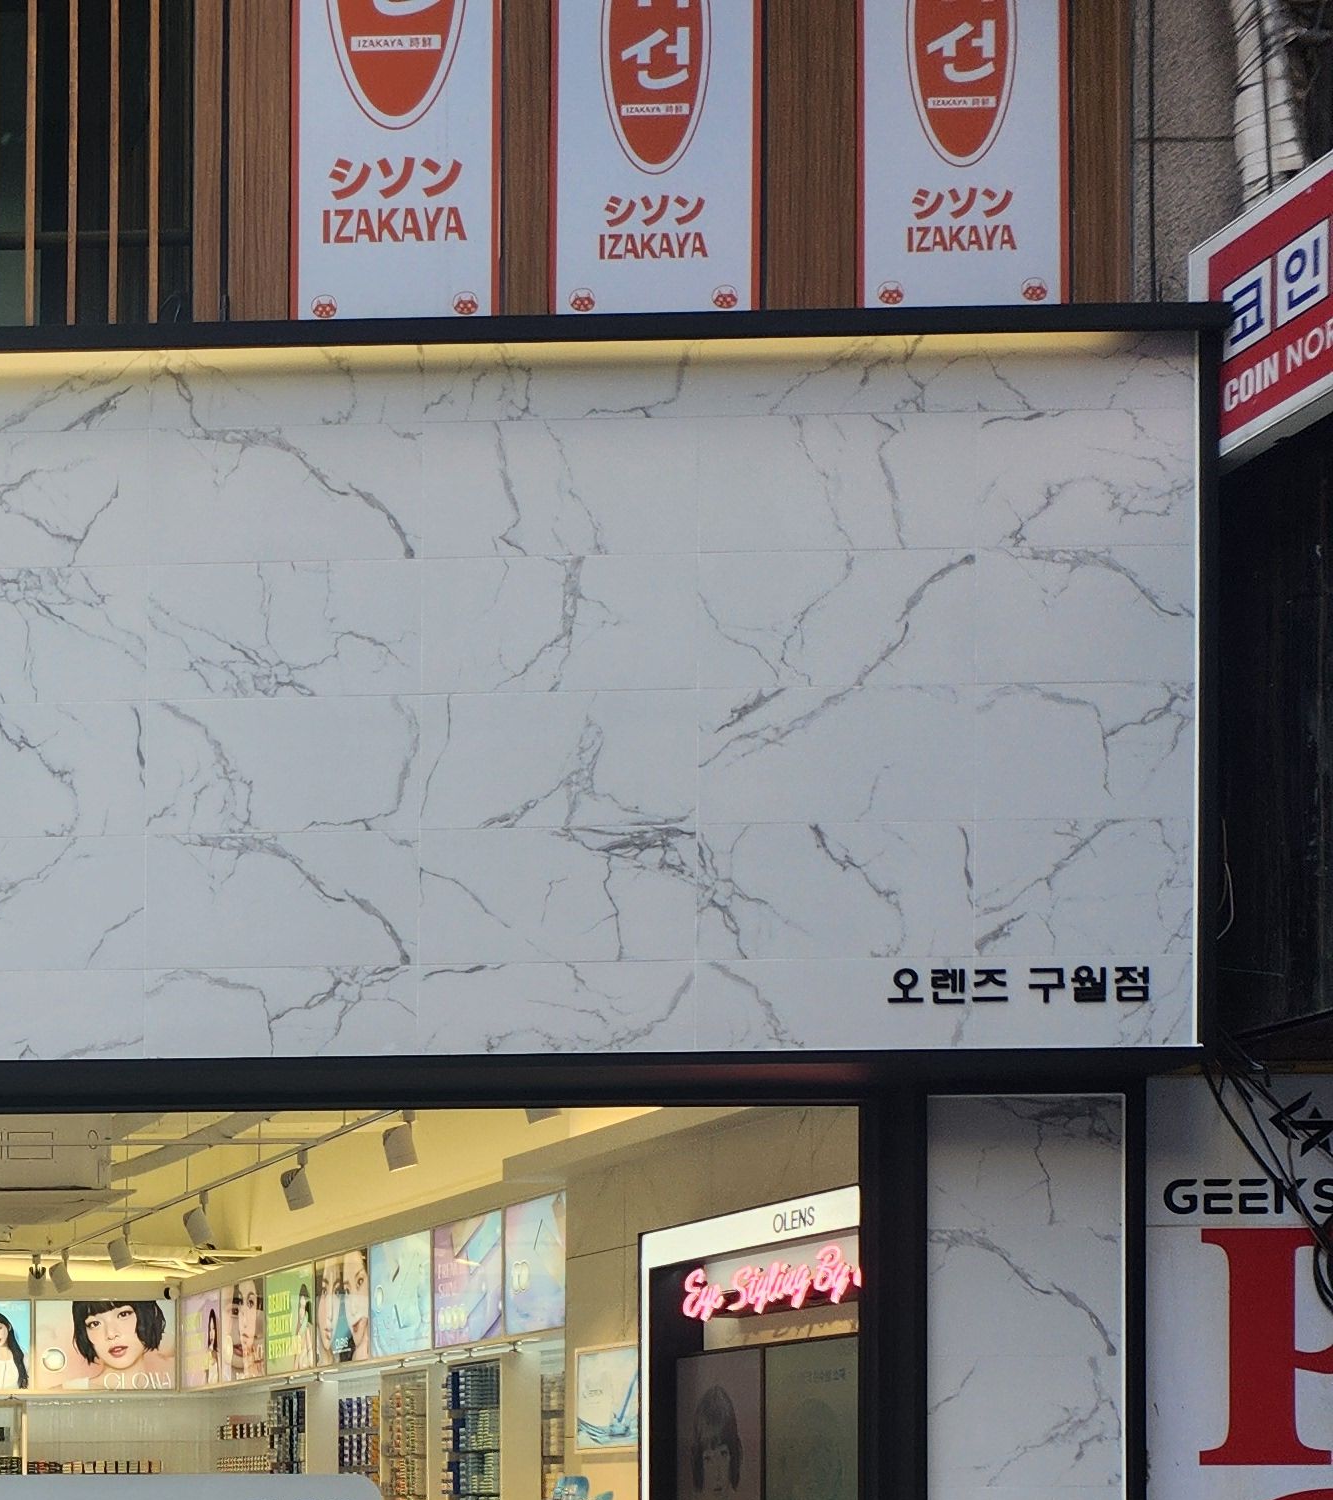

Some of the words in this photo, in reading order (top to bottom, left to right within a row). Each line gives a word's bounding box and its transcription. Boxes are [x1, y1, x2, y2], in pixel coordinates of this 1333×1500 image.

[357, 38, 403, 48] IZAKAYA
[328, 156, 464, 200] シソン
[603, 193, 705, 228] シソン
[911, 186, 1014, 220] シソン
[321, 206, 467, 245] IZAKAYA
[906, 224, 1017, 253] IZAKAYA
[598, 231, 708, 261] IZAKAYA
[1223, 351, 1279, 413] COIN
[887, 967, 1009, 1005] 오렌즈
[1028, 965, 1151, 1004] 구월점
[773, 1206, 815, 1234] OLENS
[683, 1267, 724, 1322] Eye
[726, 1261, 813, 1314] Styling
